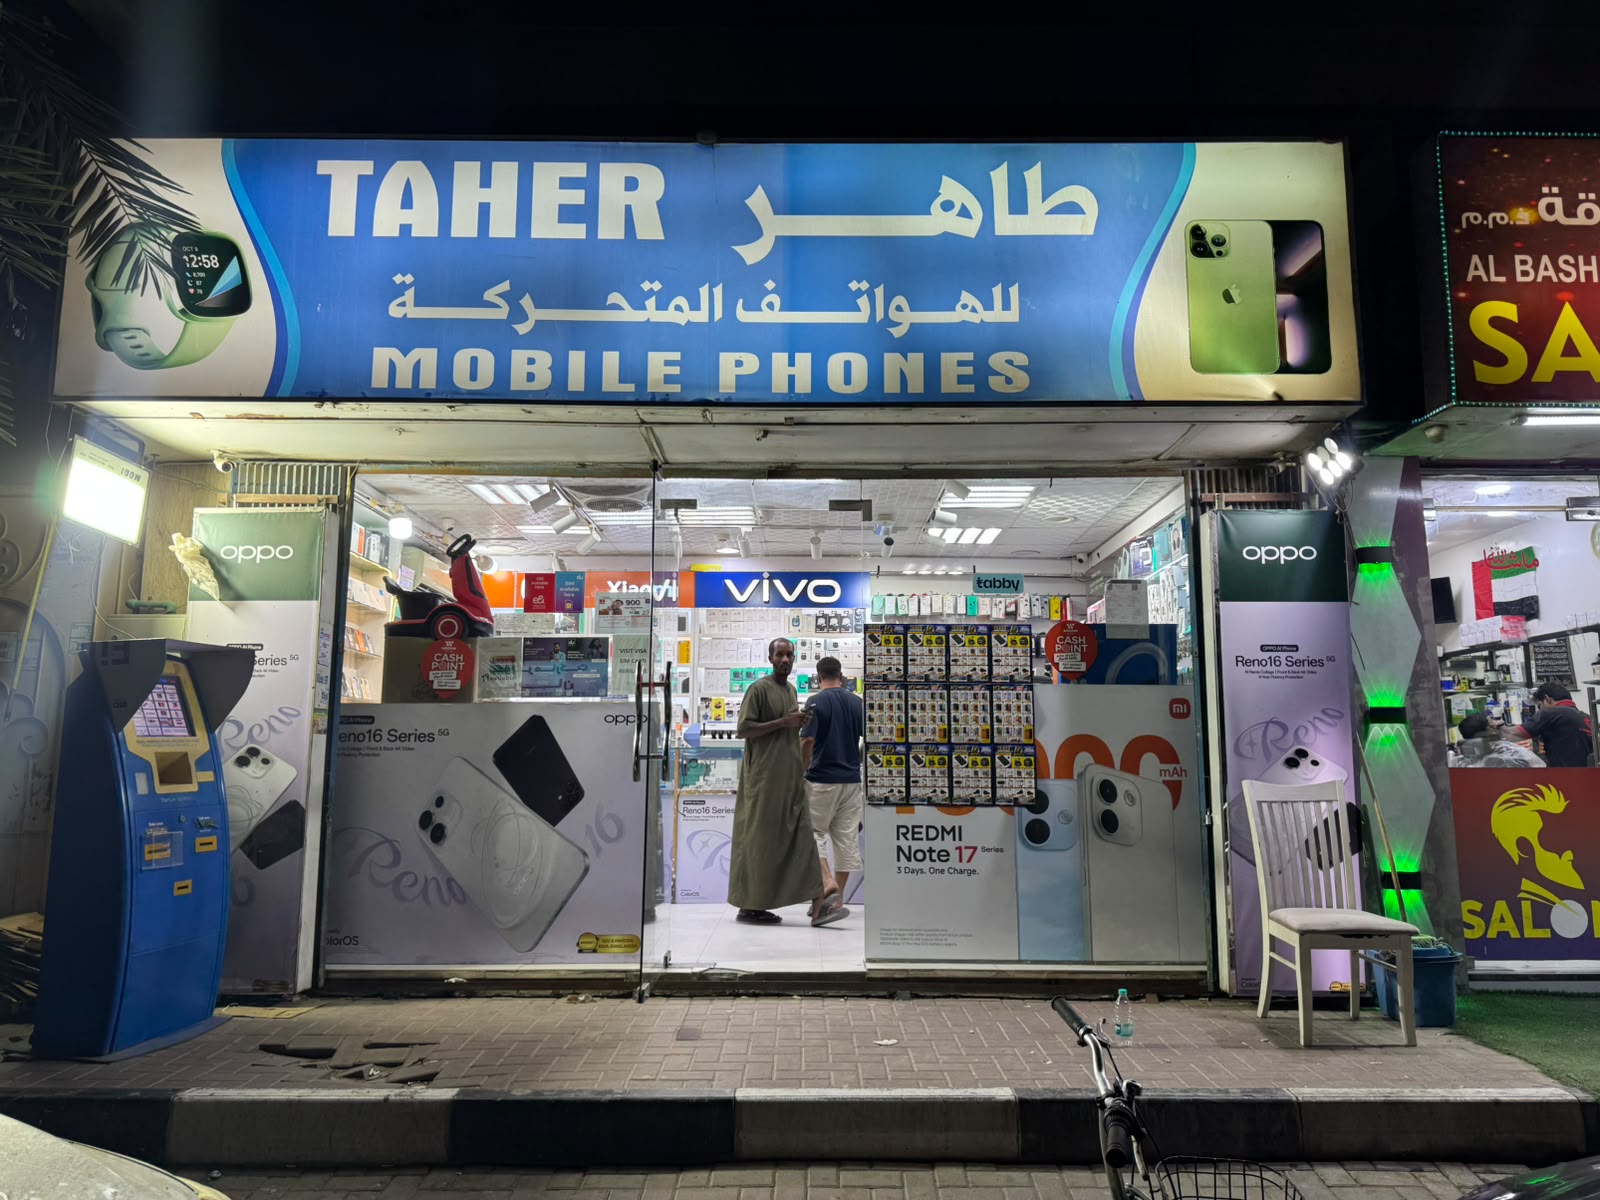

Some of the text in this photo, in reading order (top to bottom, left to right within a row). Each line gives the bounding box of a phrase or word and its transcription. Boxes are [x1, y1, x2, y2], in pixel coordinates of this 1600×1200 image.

[317, 160, 665, 240] TAHER
[730, 161, 1099, 265] طاهر
[183, 254, 219, 268] 12:58
[1466, 254, 1599, 283] AL BASH
[388, 273, 1020, 338] للهواتف المتحركة
[1469, 300, 1600, 384] SA
[371, 347, 1030, 394] MOBILE PHONES
[220, 544, 294, 563] oppo
[1242, 545, 1317, 564] oppo
[724, 571, 842, 604] vivo
[976, 574, 1020, 591] tabby
[1057, 636, 1086, 644] CASH
[434, 653, 463, 662] CASH
[1235, 655, 1282, 668] Reno16
[1285, 655, 1325, 668] Series
[338, 729, 450, 743] eno16 Series 5G
[1159, 766, 1188, 779] mAh
[682, 806, 711, 814] Reno16
[896, 824, 963, 841] REDMI
[896, 845, 950, 863] Note
[955, 846, 978, 863] 17
[904, 867, 926, 876] Days.
[947, 867, 979, 876] Charge.
[1461, 899, 1600, 939] SALO
[326, 936, 359, 946] lorOS
